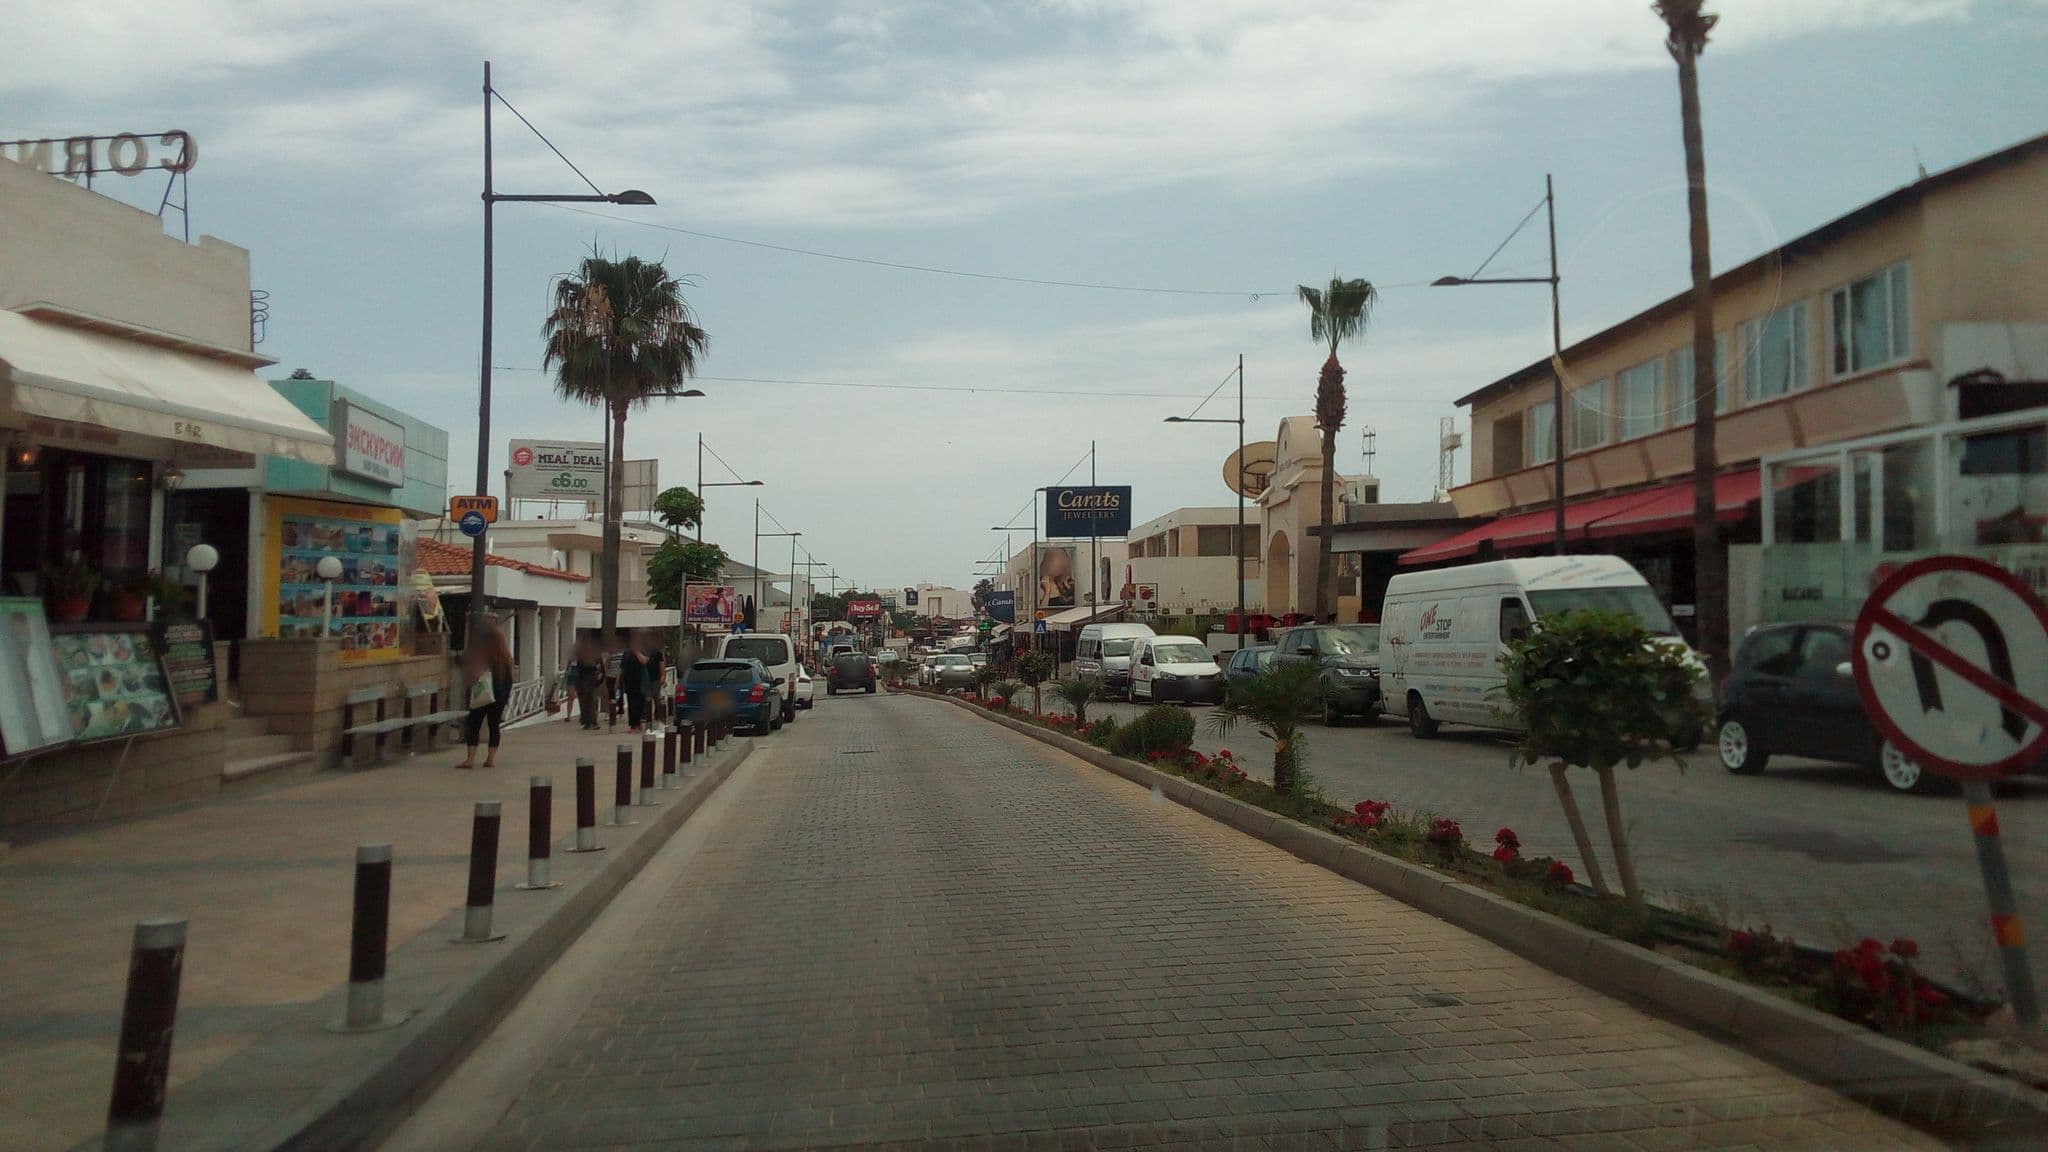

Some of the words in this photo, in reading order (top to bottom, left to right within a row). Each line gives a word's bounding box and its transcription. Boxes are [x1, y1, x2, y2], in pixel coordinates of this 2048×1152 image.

[537, 454, 570, 464] MEAL
[573, 455, 602, 466] DEAL
[551, 472, 588, 488] €6.00
[457, 498, 493, 509] ATM
[1058, 489, 1120, 508] Carats
[1419, 603, 1439, 632] ONE
[1436, 618, 1452, 632] STOP
